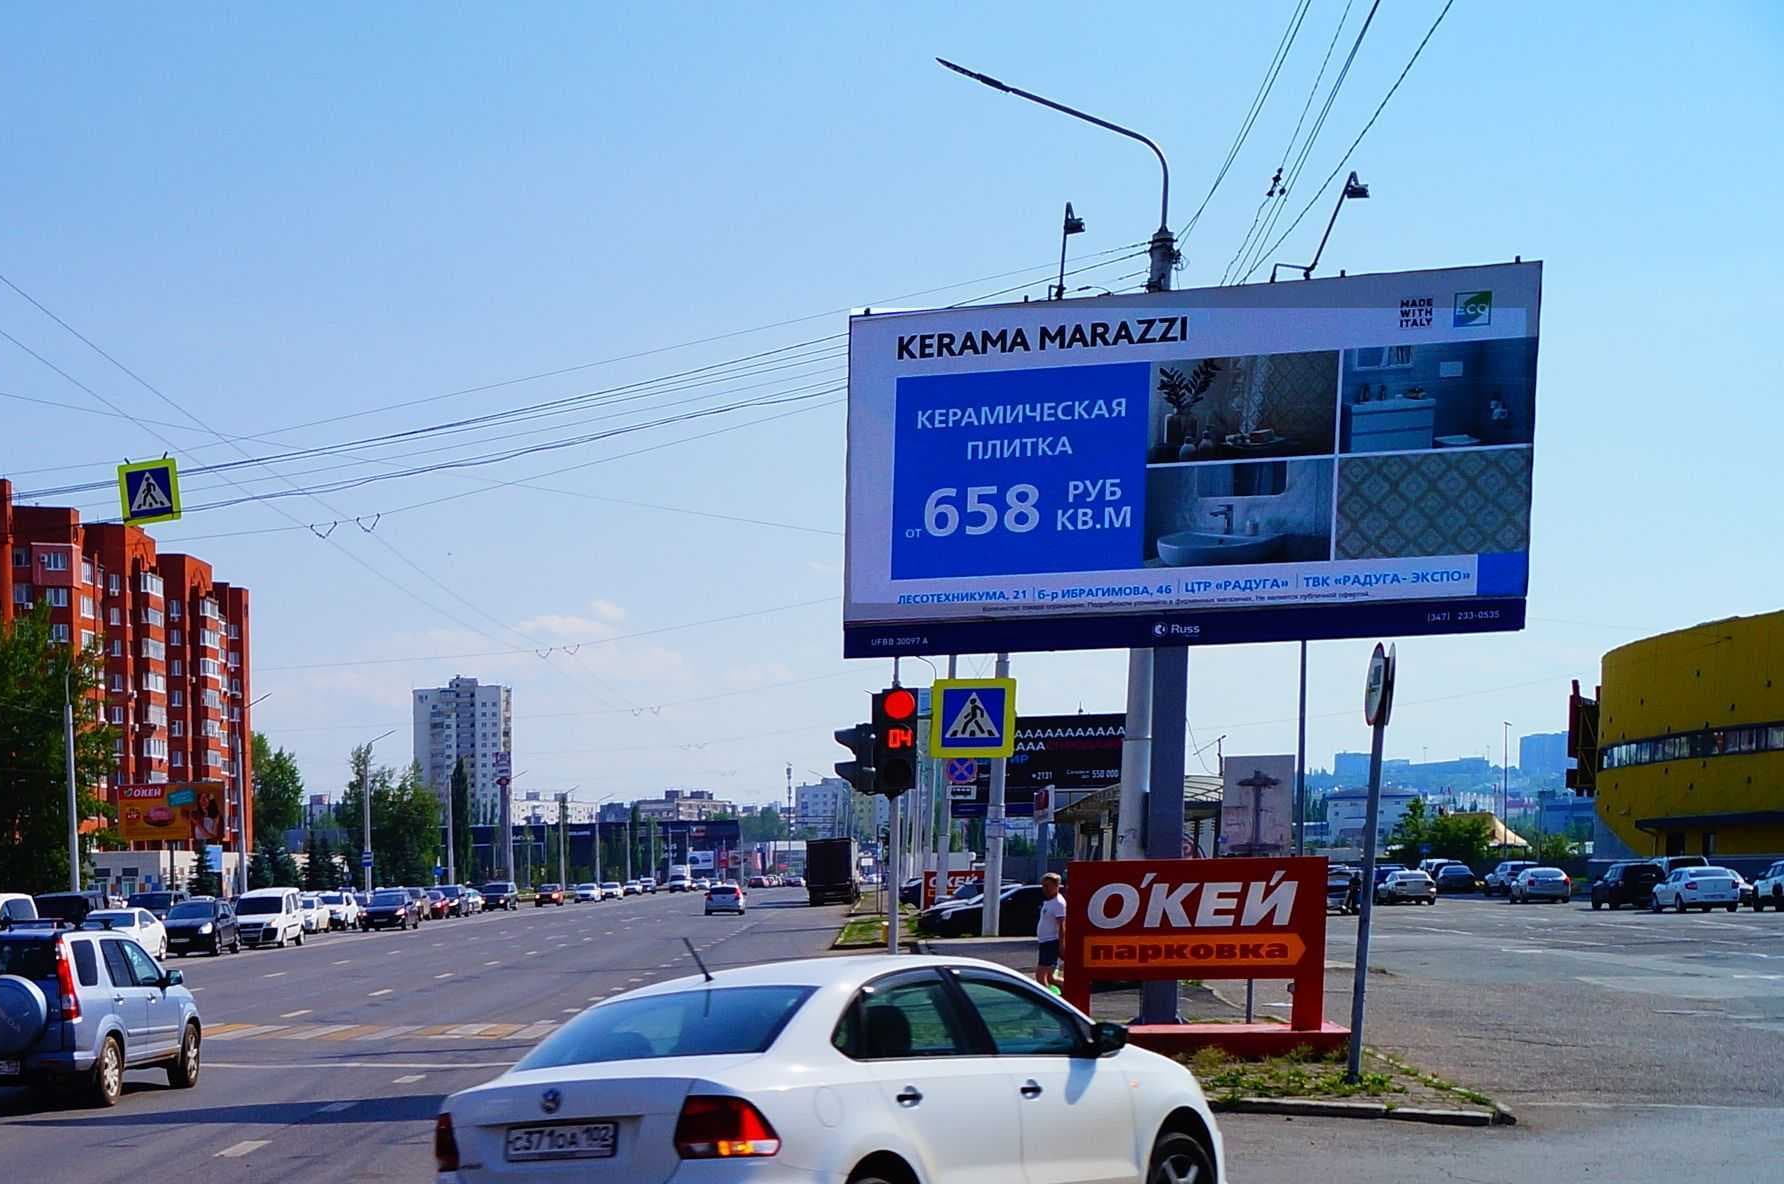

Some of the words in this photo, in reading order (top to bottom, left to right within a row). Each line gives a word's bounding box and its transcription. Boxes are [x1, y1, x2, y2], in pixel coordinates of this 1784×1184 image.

[1400, 298, 1433, 308] MADE
[1400, 308, 1433, 318] WITH
[1400, 318, 1433, 328] ITALY
[897, 328, 1031, 360] KERAMA
[1039, 316, 1188, 351] MARAZZI
[916, 398, 1127, 430] КЕРАМИЧЕСКАЯ
[967, 436, 1073, 460] ПЛИТКА
[1068, 478, 1123, 503] РУБ
[905, 528, 923, 538] от
[924, 483, 1040, 537] 658
[1056, 506, 1132, 532] КВ.М
[1184, 581, 1212, 594] ЦТР
[1216, 577, 1289, 592] «РАДУГА»
[1303, 575, 1331, 588] ТВК
[897, 590, 1010, 605] ЛЕСОТЕХНИКУМА,
[1013, 590, 1027, 600] 21
[1037, 589, 1059, 601] б-р
[1061, 585, 1154, 599] ИБРАГИМОВА,
[1156, 585, 1173, 595] 46
[1171, 624, 1201, 634] Russ
[888, 728, 912, 748] 04
[1091, 942, 1289, 964] парковка
